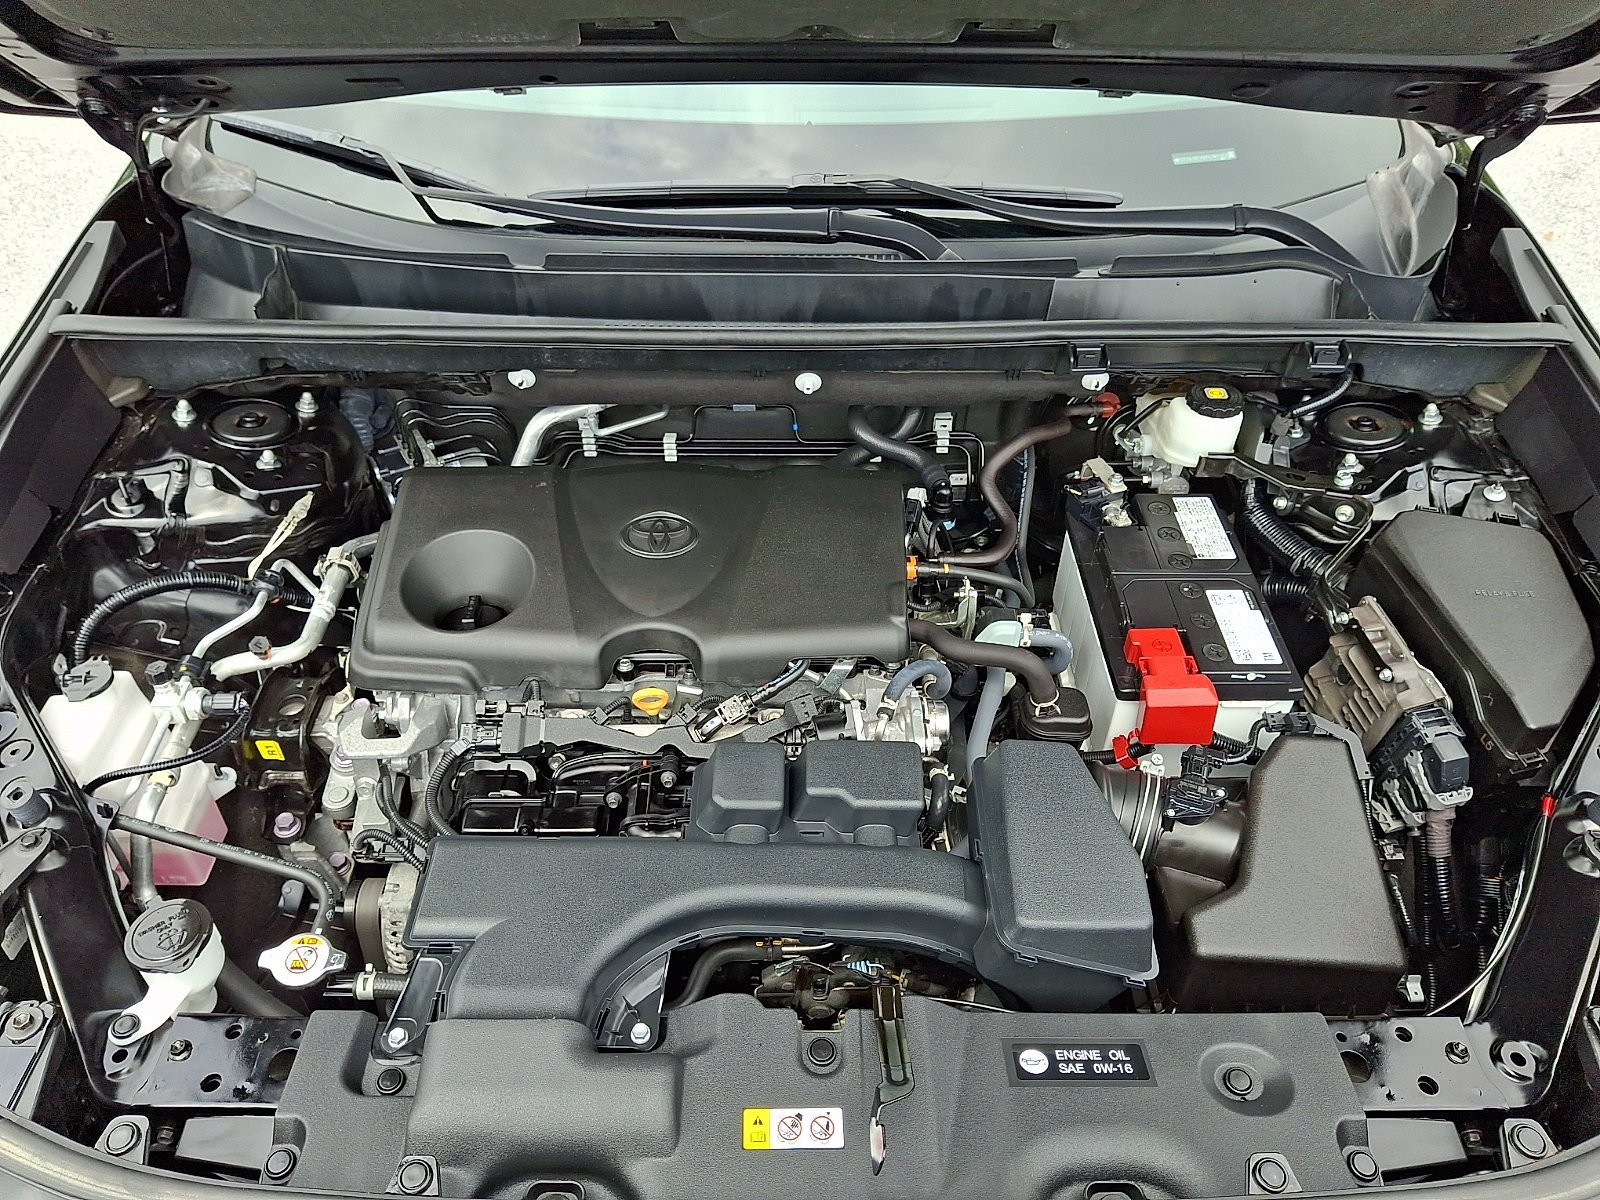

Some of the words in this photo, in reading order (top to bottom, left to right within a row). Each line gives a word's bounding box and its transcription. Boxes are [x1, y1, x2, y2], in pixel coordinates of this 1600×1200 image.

[156, 922, 173, 933] ONLY
[1055, 1049, 1102, 1060] ENGINE
[1108, 1049, 1130, 1060] OIL
[1058, 1063, 1085, 1073] SAE
[1093, 1063, 1133, 1073] 0W-16
